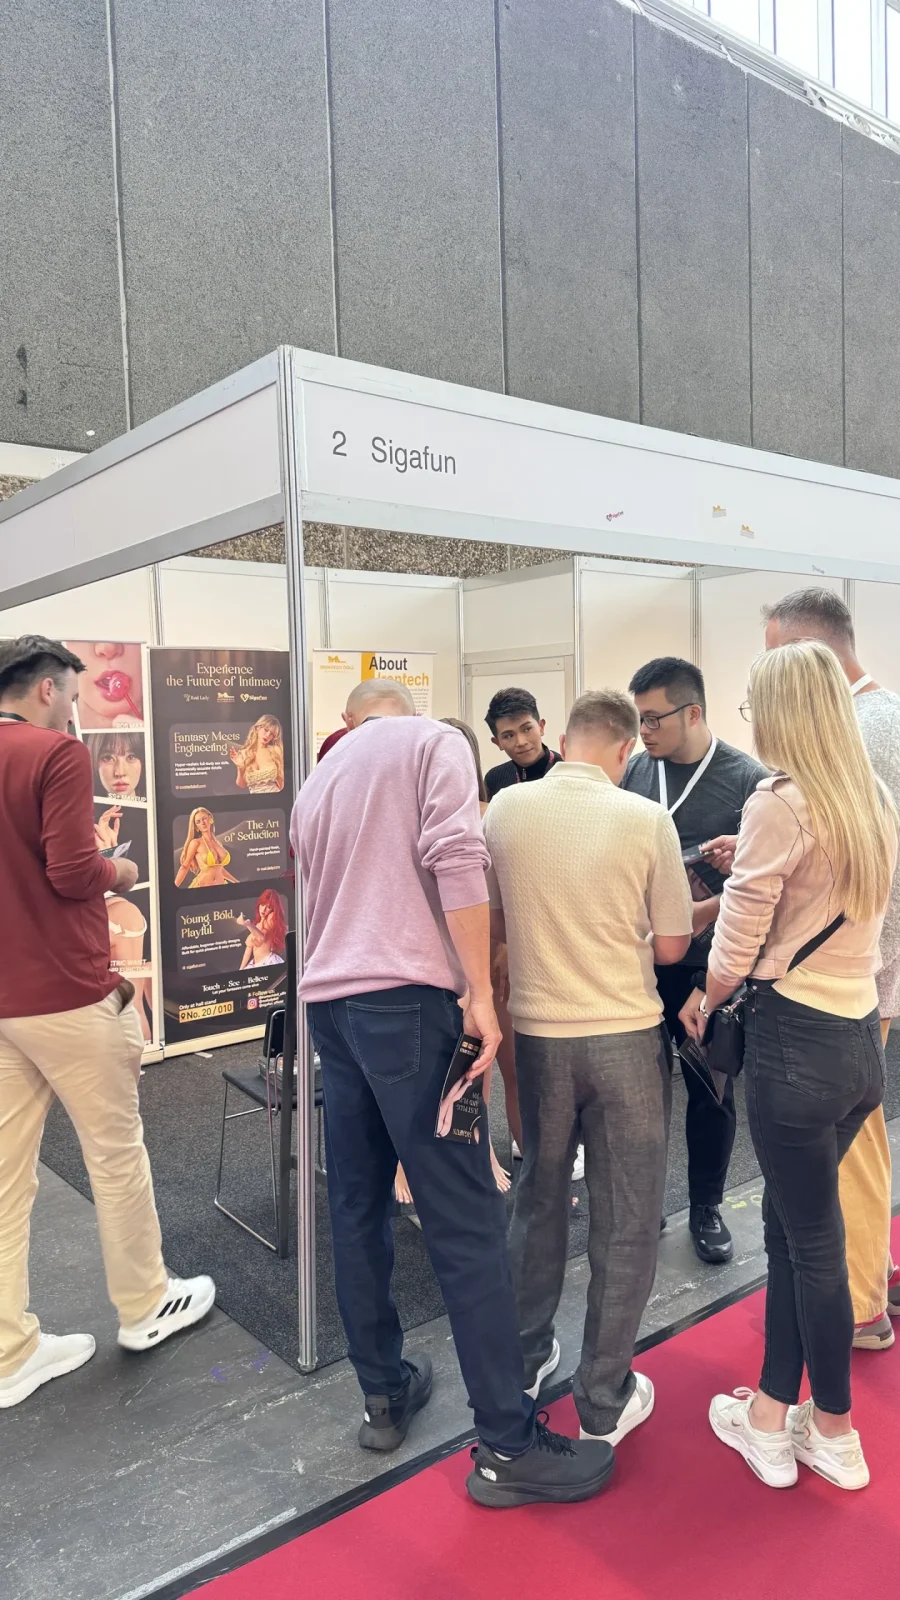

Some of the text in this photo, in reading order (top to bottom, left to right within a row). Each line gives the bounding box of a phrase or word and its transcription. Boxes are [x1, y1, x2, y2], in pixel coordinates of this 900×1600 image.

[332, 430, 456, 475] 2 Sigafun
[196, 662, 253, 677] Experience
[369, 656, 408, 671] About
[166, 675, 282, 689] the Future of Intimacy
[174, 731, 240, 744] Fantasy Meets
[174, 742, 228, 757] Engineering
[246, 819, 279, 830] The Art
[224, 829, 279, 842] of Seduction
[213, 909, 234, 921] Bold.
[181, 925, 214, 939] Playful.
[202, 982, 220, 992] Touch
[247, 975, 268, 984] Believe
[186, 1011, 200, 1020] No.
[202, 1008, 211, 1017] 20
[217, 1003, 233, 1014] 010
